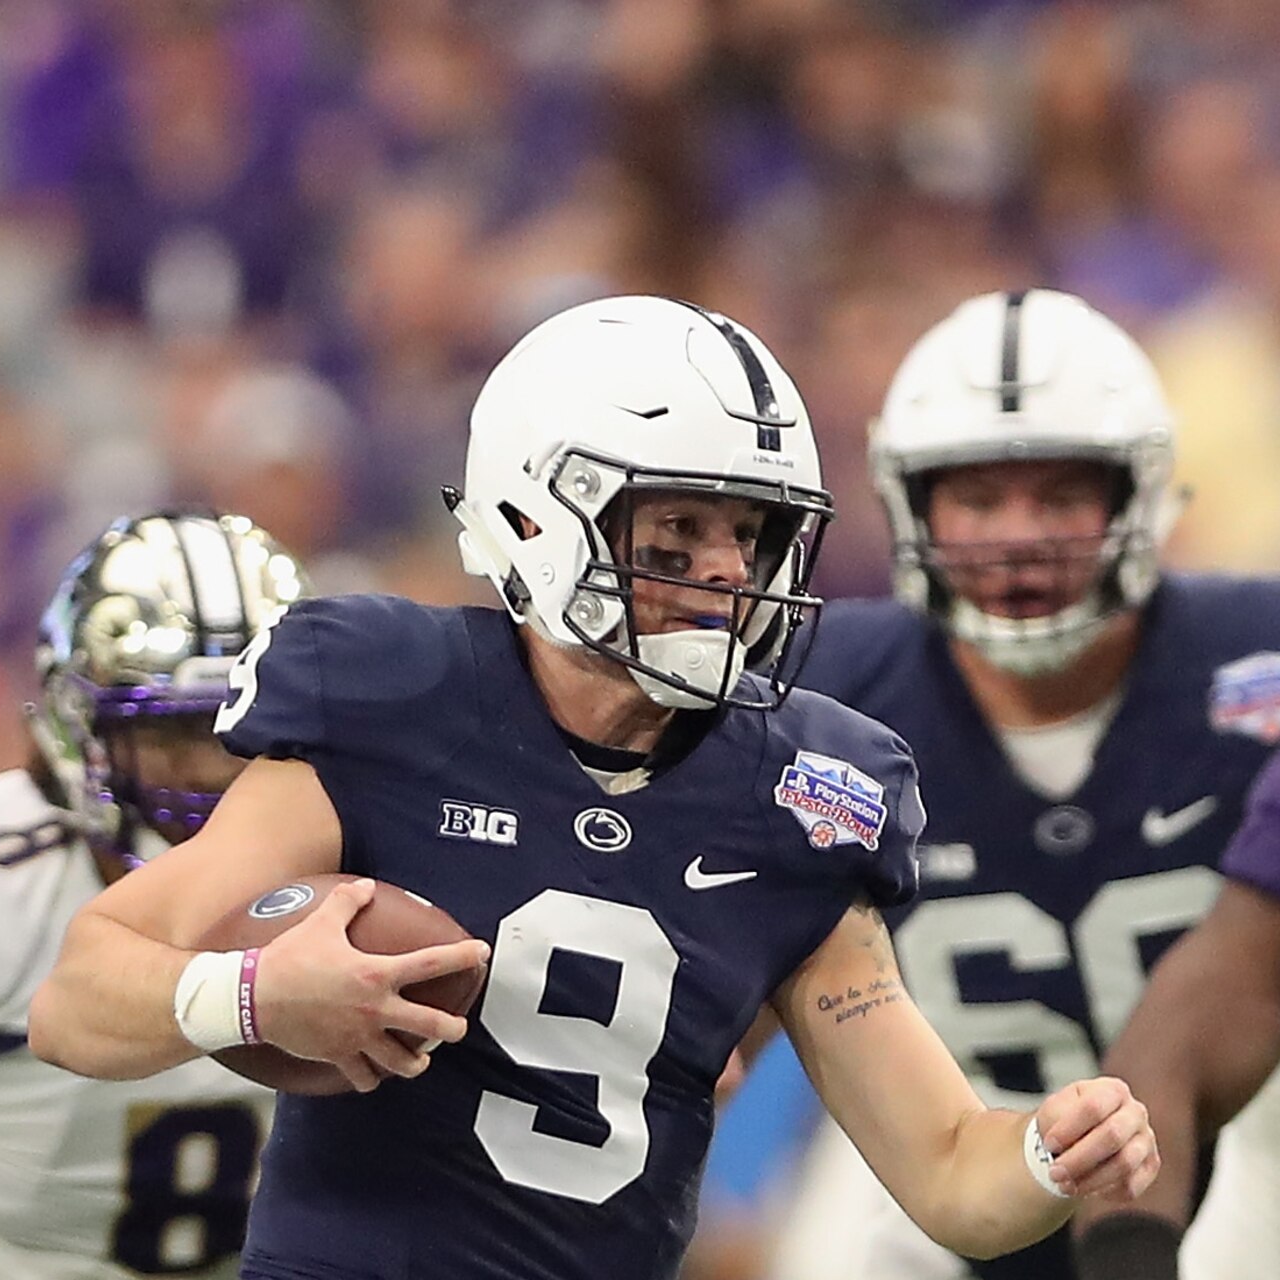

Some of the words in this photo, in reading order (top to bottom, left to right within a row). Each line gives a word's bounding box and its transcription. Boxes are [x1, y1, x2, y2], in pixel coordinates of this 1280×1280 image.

[213, 603, 289, 734] 9
[814, 782, 879, 823] PlayStation
[473, 888, 680, 1204] 9
[108, 1099, 261, 1280] 8
